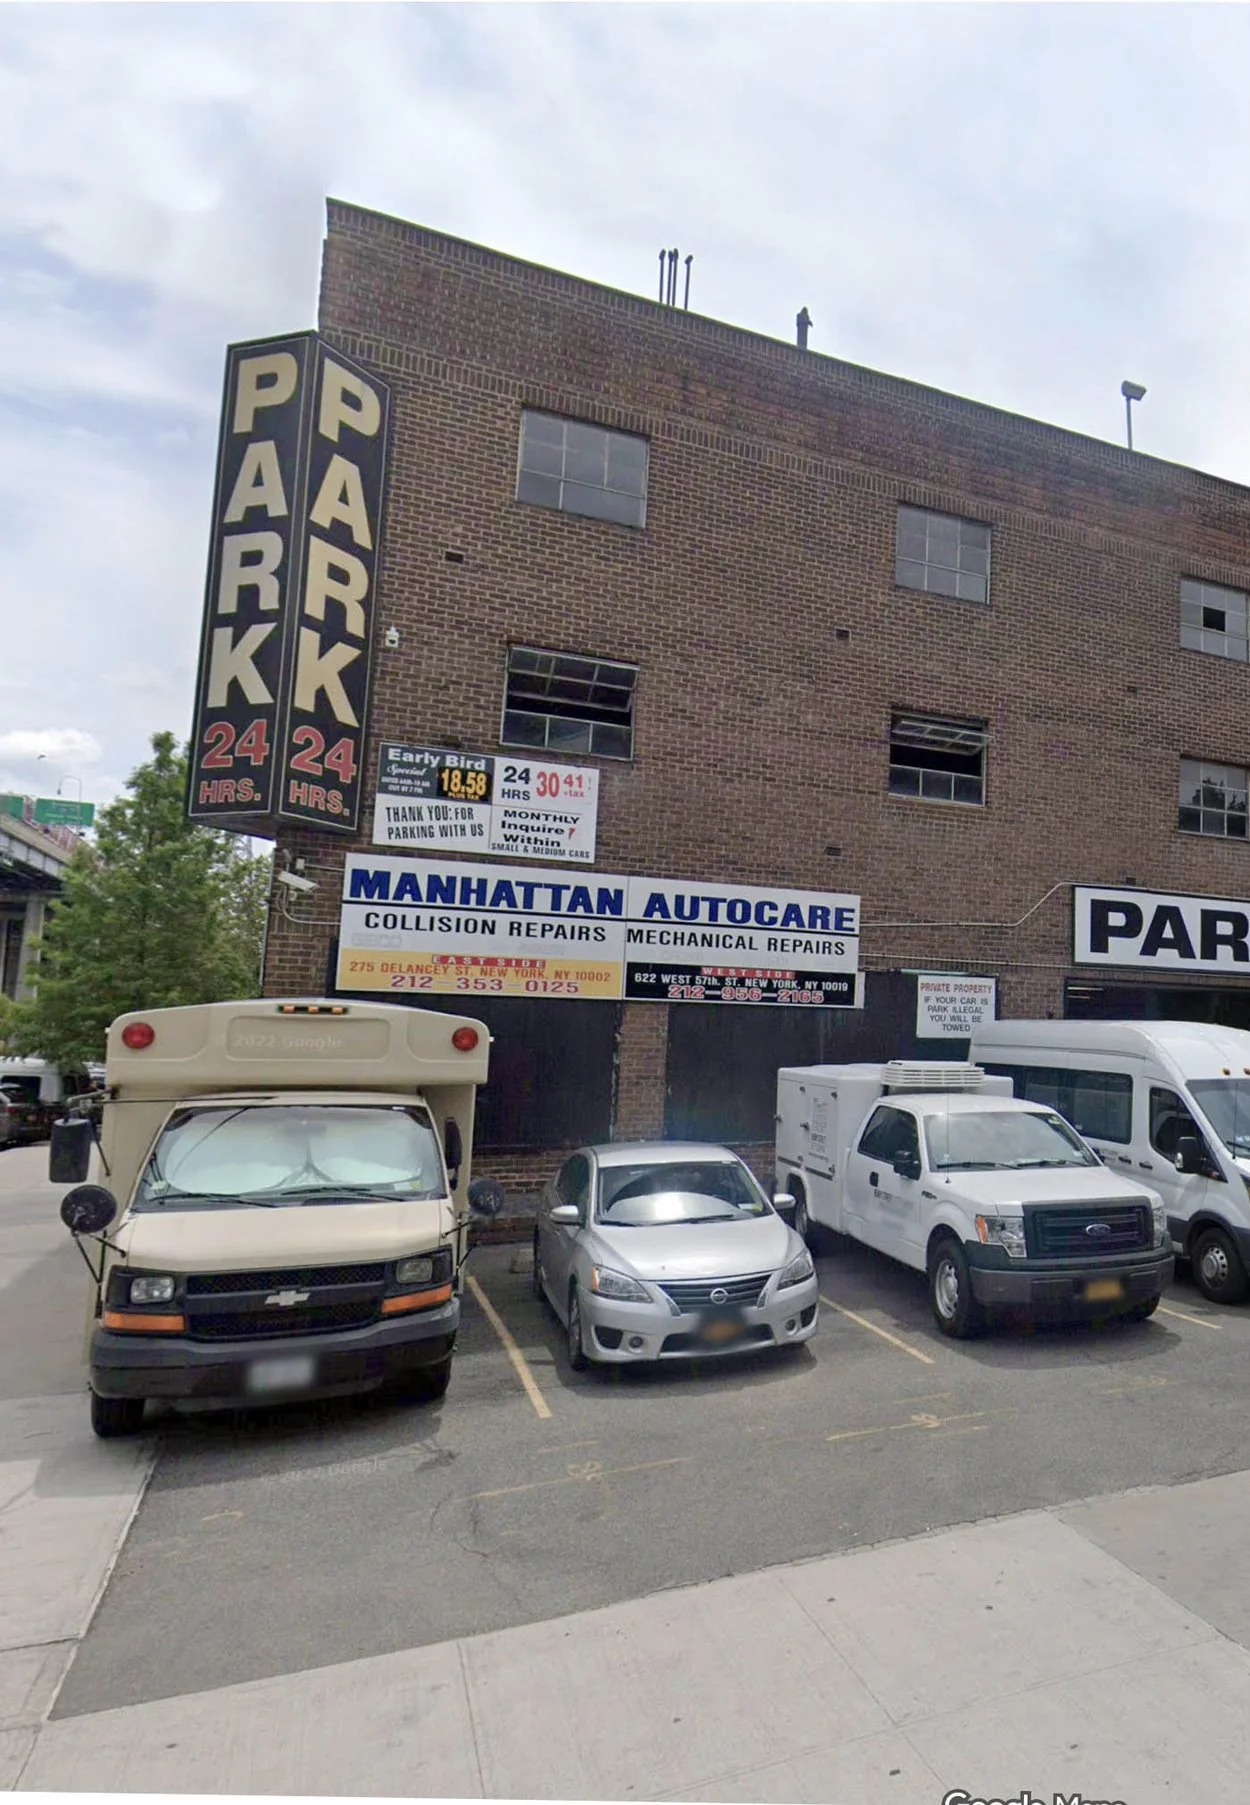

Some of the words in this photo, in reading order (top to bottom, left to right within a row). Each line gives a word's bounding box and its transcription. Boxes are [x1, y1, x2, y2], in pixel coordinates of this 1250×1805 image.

[206, 352, 298, 708] PARK
[293, 357, 381, 728] PARK
[200, 719, 270, 769] 24
[289, 725, 357, 783] 24
[387, 747, 441, 768] Early
[444, 754, 487, 771] Bird
[386, 763, 427, 777] Special
[503, 765, 531, 785] 24
[441, 768, 487, 796] 18.58
[536, 771, 560, 798] 30
[563, 774, 584, 788] 41
[198, 780, 262, 805] HRS.
[288, 782, 350, 817] HRS.
[501, 788, 531, 801] HRS
[385, 806, 424, 823] THANK
[454, 806, 474, 821] FOR
[503, 809, 580, 825] MONTHLY
[387, 823, 435, 840] PARKING
[438, 823, 467, 839] WITH
[469, 822, 484, 837] US
[501, 820, 565, 835] Inquire
[491, 843, 519, 852] SMALL
[532, 846, 566, 855] MEDIUM
[568, 849, 590, 858] CARS
[503, 833, 561, 848] Within
[348, 868, 625, 916] MANHATTAN
[642, 892, 856, 932] AUTOCARE
[364, 912, 497, 935] COLLISION
[508, 921, 607, 942] REPAIRS
[626, 927, 759, 951] MECHANICAL
[766, 938, 846, 956] REPAIRS
[431, 955, 487, 966] EAST
[495, 957, 546, 968] SIDE
[349, 961, 375, 973] 275
[380, 961, 452, 976] DELANCEY
[479, 967, 508, 979] NEW
[553, 969, 571, 981] NY
[575, 970, 612, 983] 10002
[634, 972, 657, 983] 622
[661, 973, 691, 985] WEST
[745, 977, 768, 988] NEW
[804, 980, 820, 991] NY
[821, 980, 848, 992] 10019
[700, 966, 747, 977] WEST
[754, 969, 795, 979] SIDE
[920, 982, 950, 992] PRIVATE
[953, 983, 993, 994] PROPERTY
[927, 1005, 949, 1013] PARK
[952, 1006, 984, 1014] ILLEGAL
[935, 996, 957, 1004] YOUR
[960, 997, 977, 1005] CAR
[949, 1015, 968, 1023] WILL
